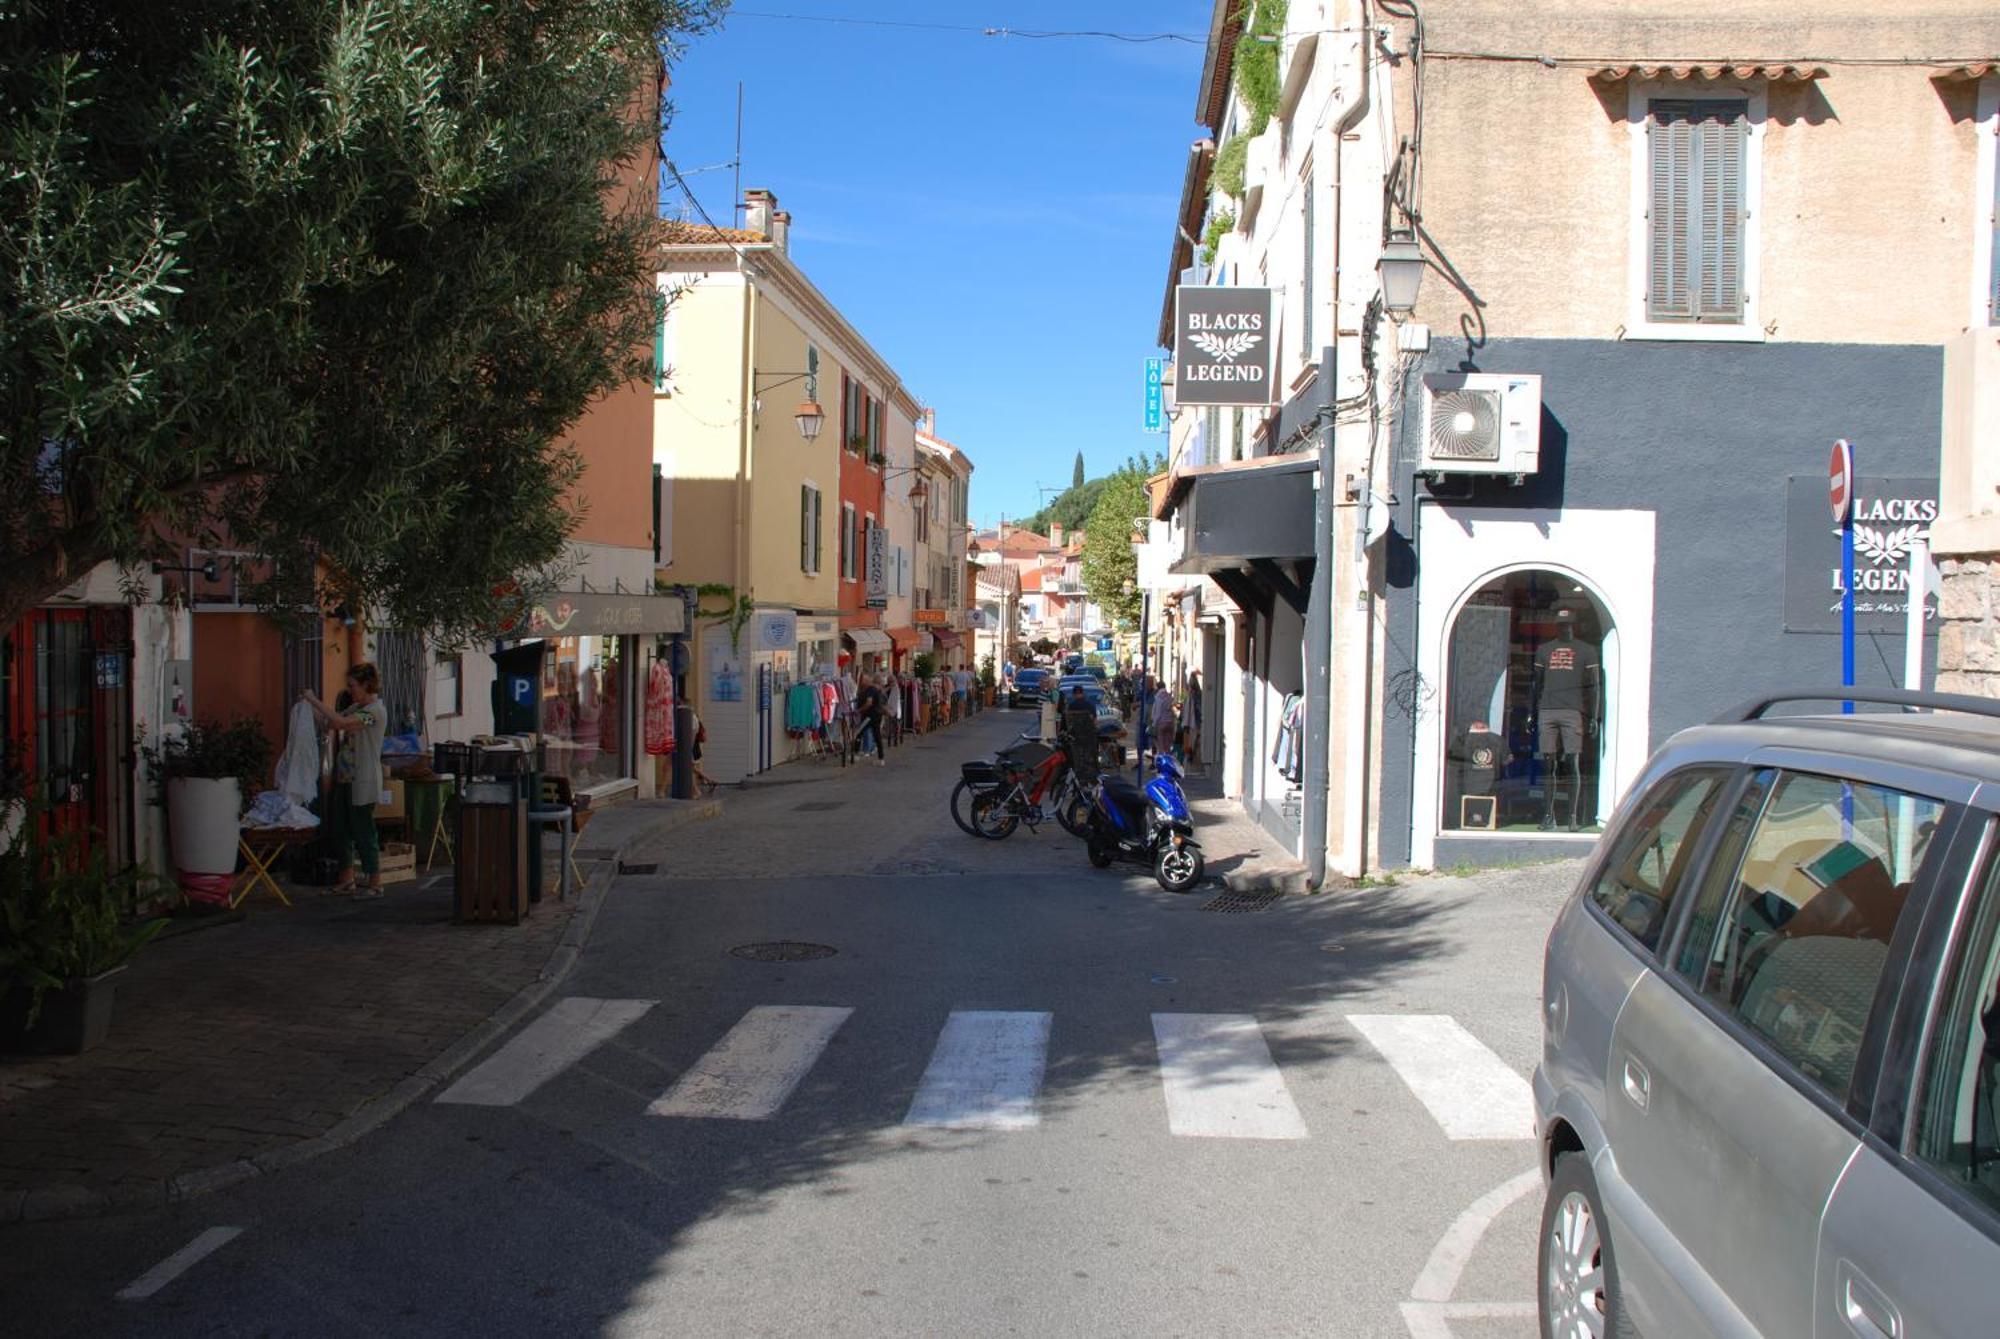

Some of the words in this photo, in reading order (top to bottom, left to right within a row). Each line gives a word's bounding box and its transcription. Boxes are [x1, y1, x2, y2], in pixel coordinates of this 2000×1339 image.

[1188, 313, 1262, 330] BLACKS
[1186, 364, 1263, 381] LEGEND
[1149, 360, 1157, 423] HÔTEL
[1854, 498, 1937, 521] LACKS
[1831, 568, 1911, 591] LEGEN
[514, 679, 530, 702] P
